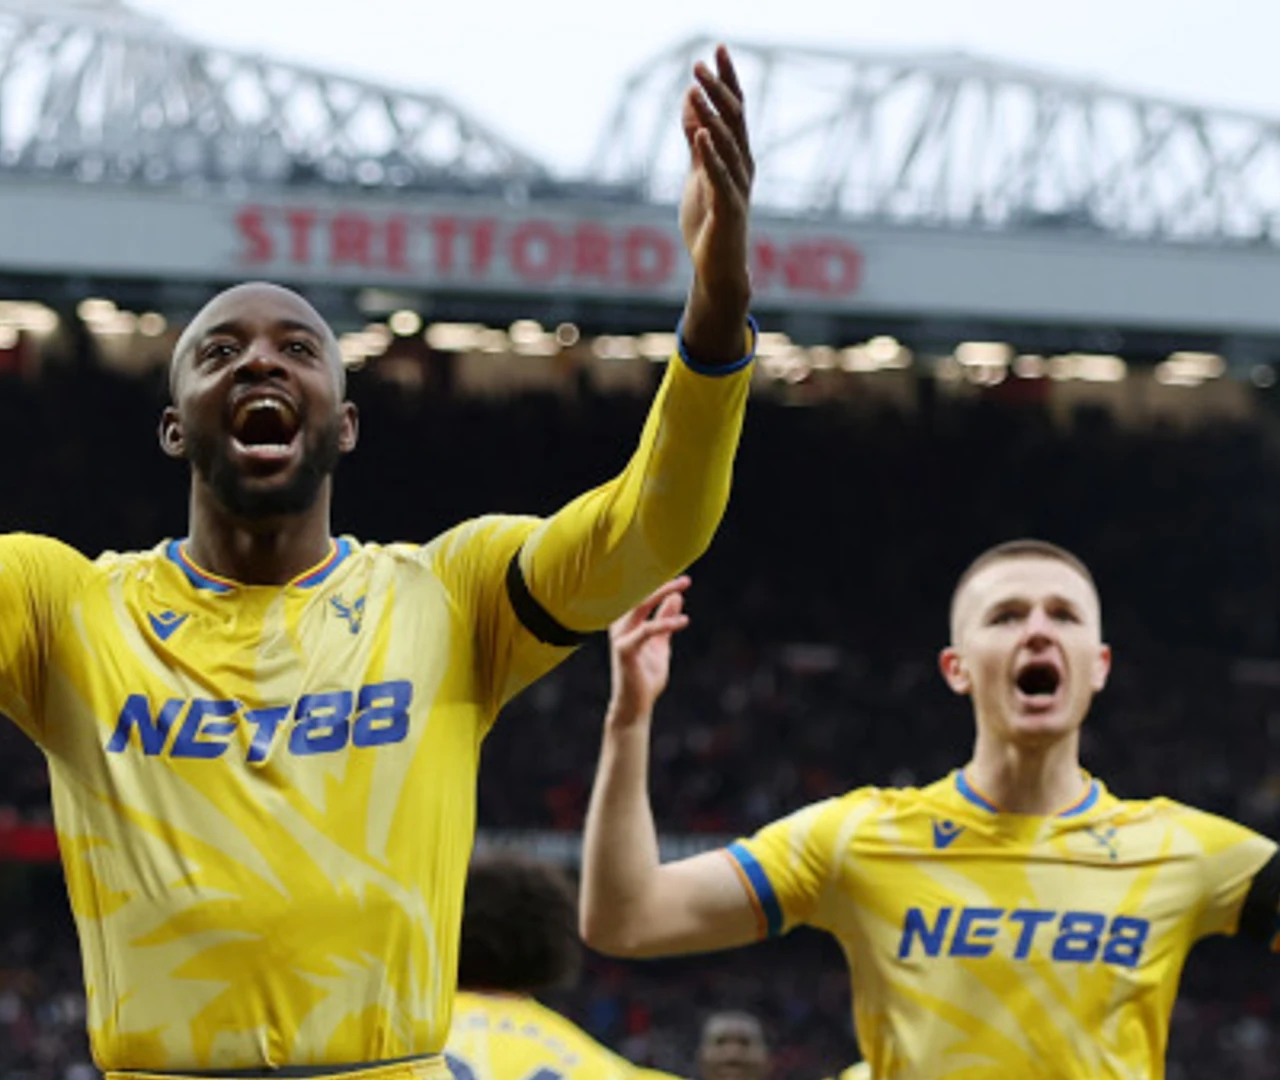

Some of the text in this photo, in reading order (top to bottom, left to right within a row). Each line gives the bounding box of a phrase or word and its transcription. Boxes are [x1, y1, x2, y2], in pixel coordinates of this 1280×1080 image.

[235, 203, 677, 288] STRETFORD
[106, 679, 414, 763] NET88
[897, 906, 1151, 968] NET88
